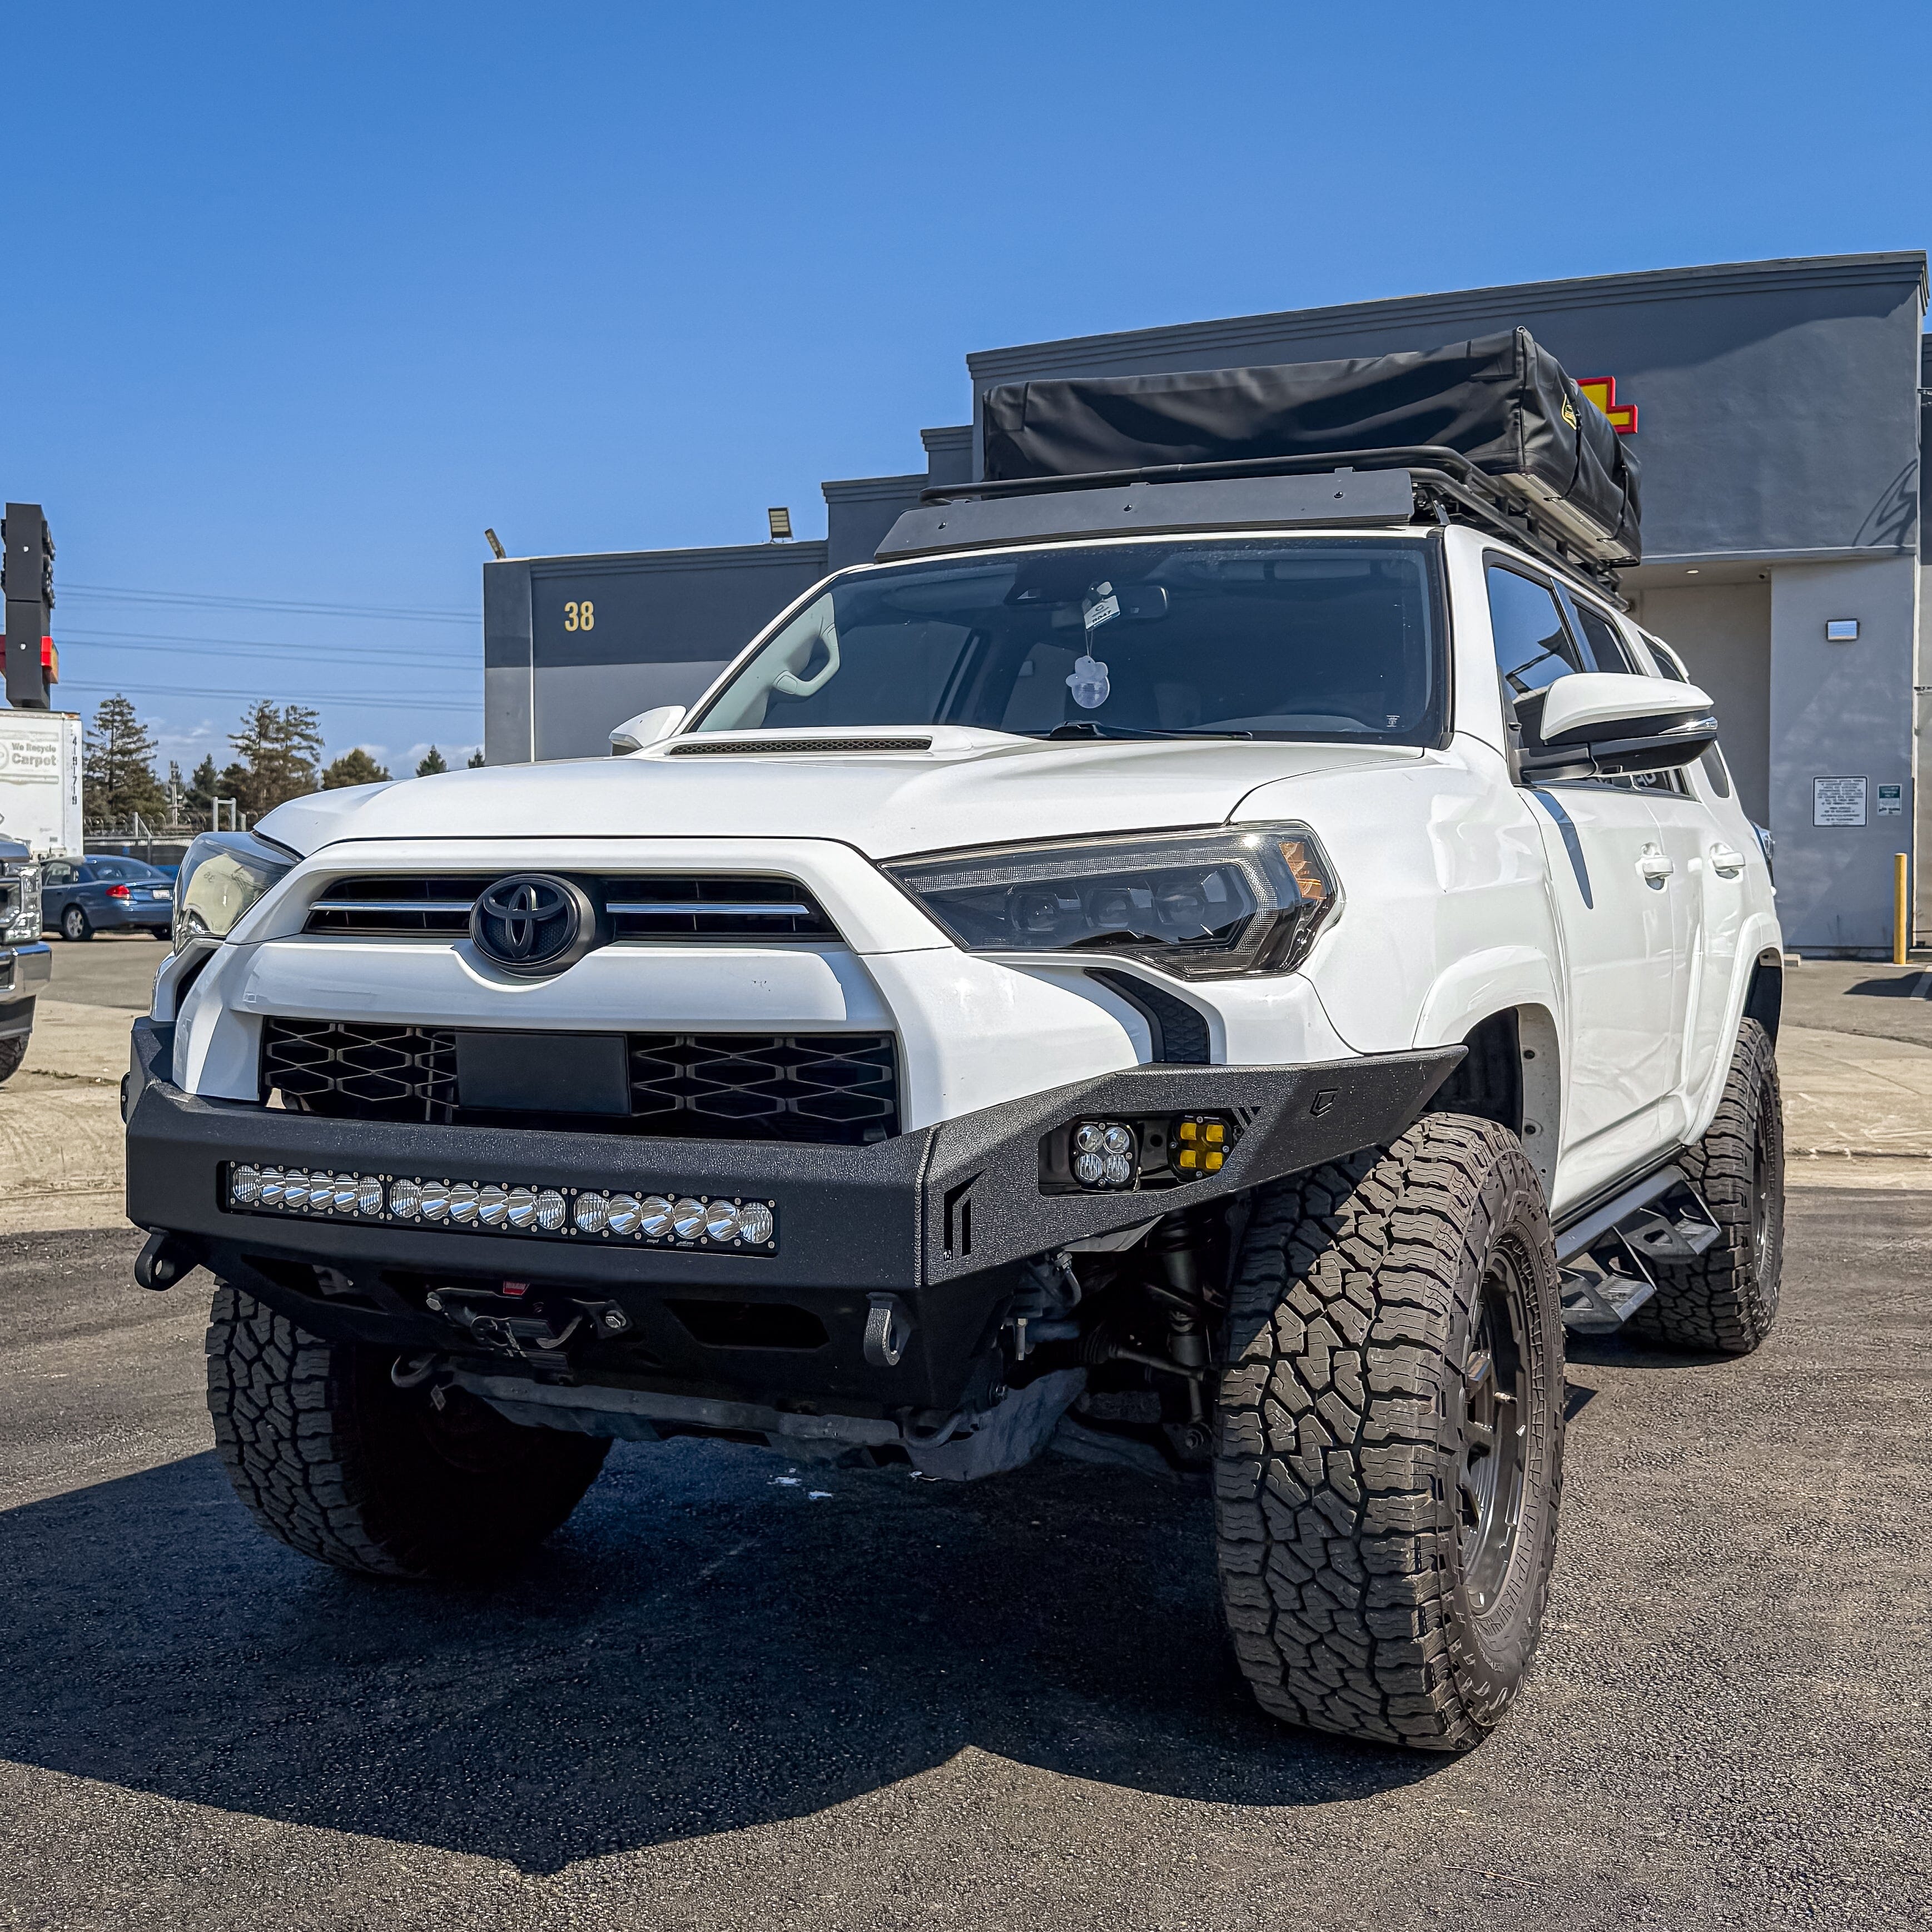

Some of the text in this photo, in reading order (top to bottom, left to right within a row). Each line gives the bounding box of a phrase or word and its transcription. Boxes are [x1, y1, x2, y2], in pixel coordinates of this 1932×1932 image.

[564, 601, 594, 632] 38
[12, 742, 56, 754] We Recycle
[12, 753, 57, 768] Carpet
